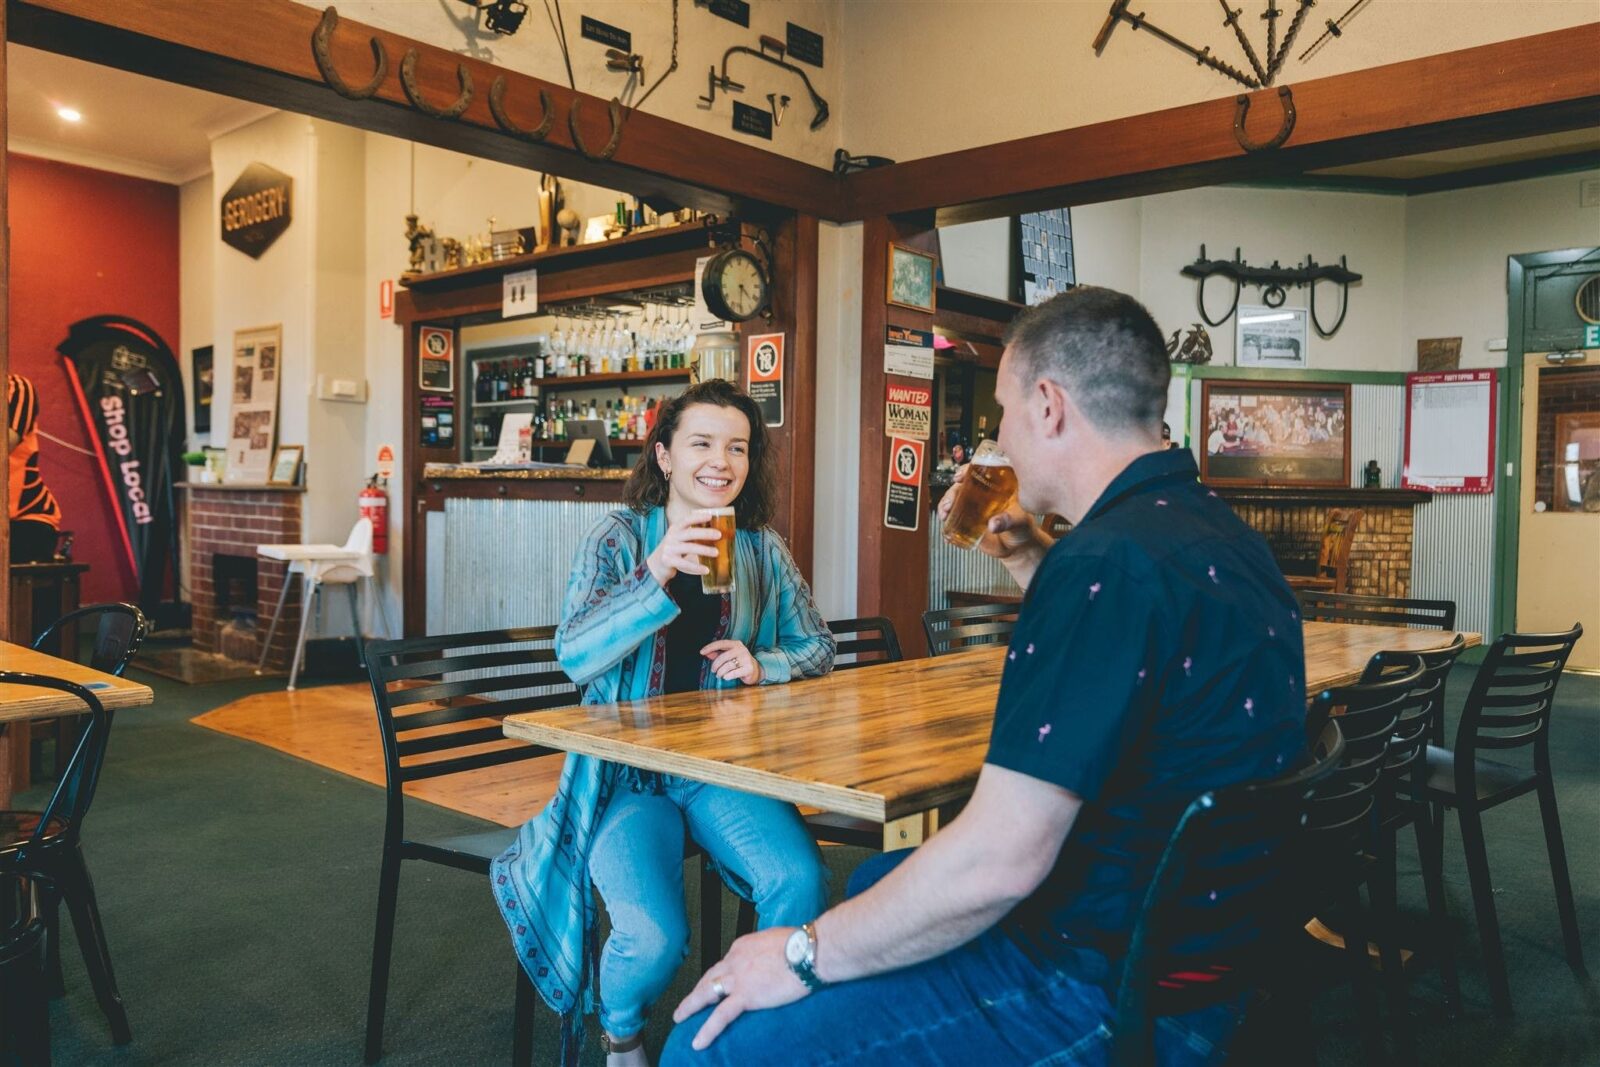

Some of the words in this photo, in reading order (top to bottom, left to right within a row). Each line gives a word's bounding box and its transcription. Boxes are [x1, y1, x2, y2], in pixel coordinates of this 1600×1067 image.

[1586, 326, 1599, 347] E
[888, 387, 929, 405] WANTED
[888, 403, 929, 421] WOMAN
[100, 395, 132, 456] Shop
[120, 460, 153, 524] Local
